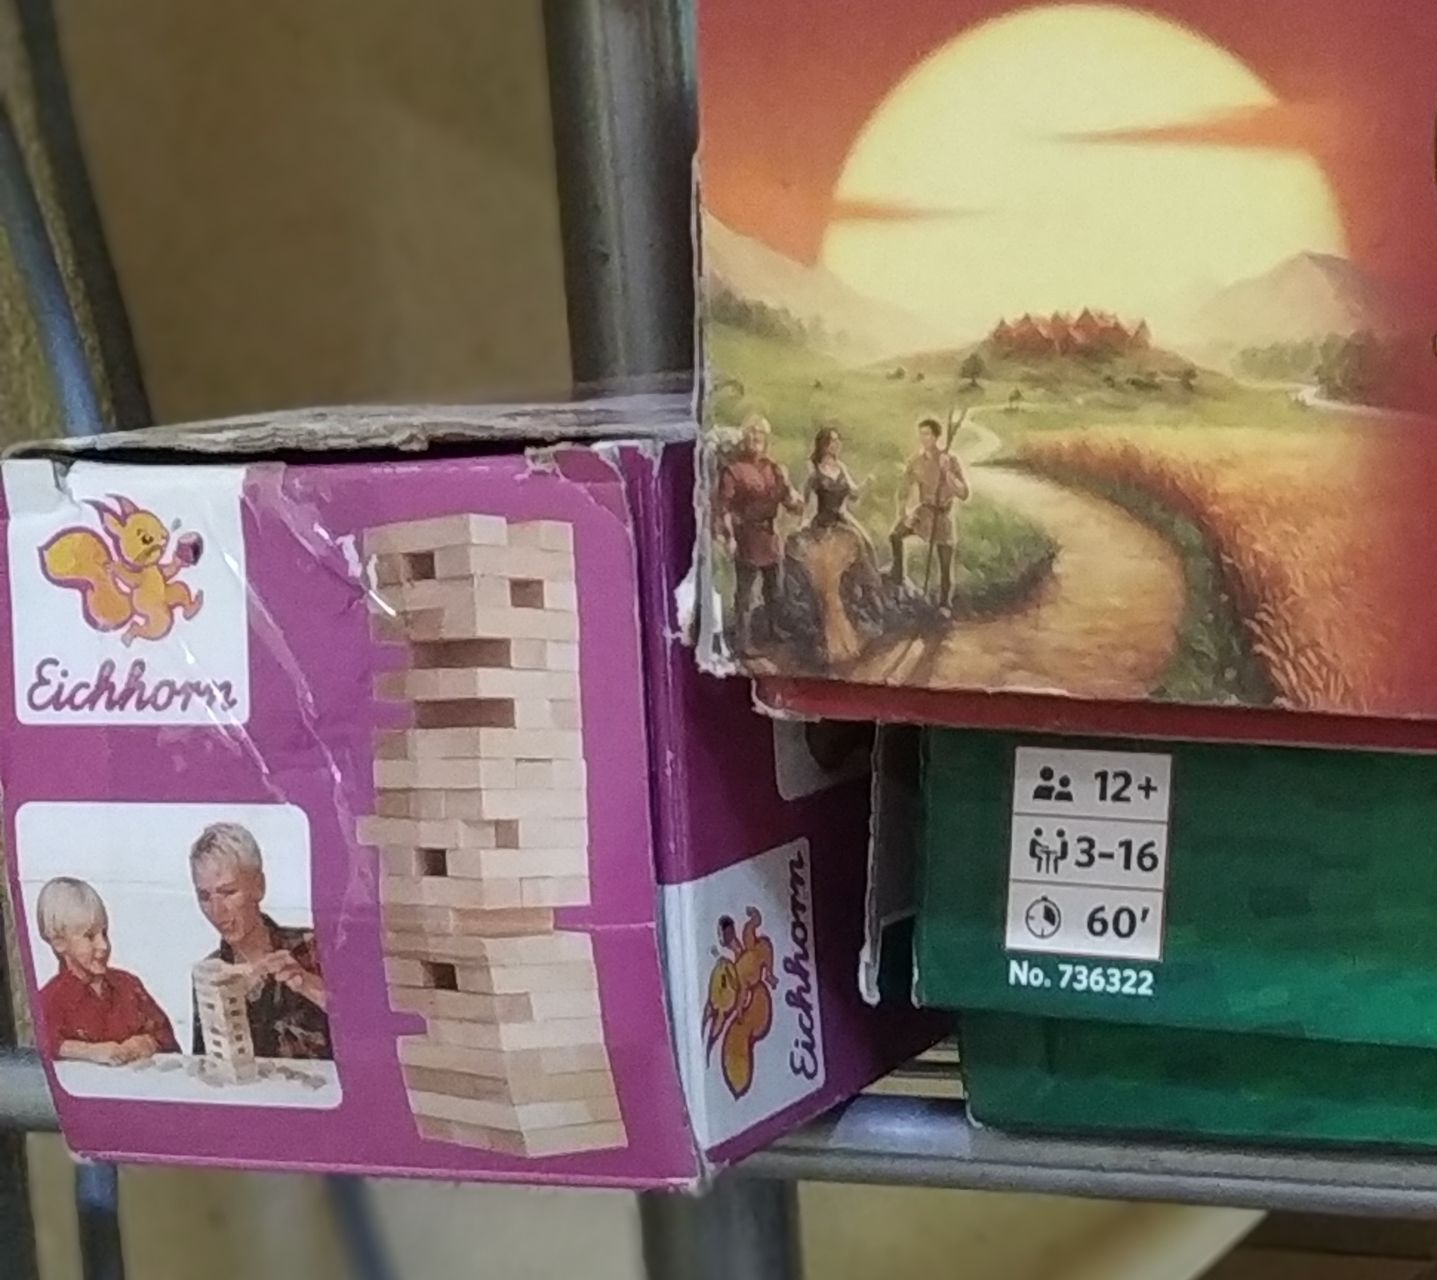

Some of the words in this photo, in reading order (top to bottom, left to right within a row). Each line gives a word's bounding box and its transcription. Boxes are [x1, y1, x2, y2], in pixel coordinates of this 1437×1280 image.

[26, 657, 239, 713] Eichhorn
[1094, 770, 1158, 802] 12+
[1074, 836, 1159, 873] 3-16
[783, 850, 818, 1080] Eichhorn
[1008, 960, 1050, 989] No.
[1058, 964, 1154, 996] 736322
